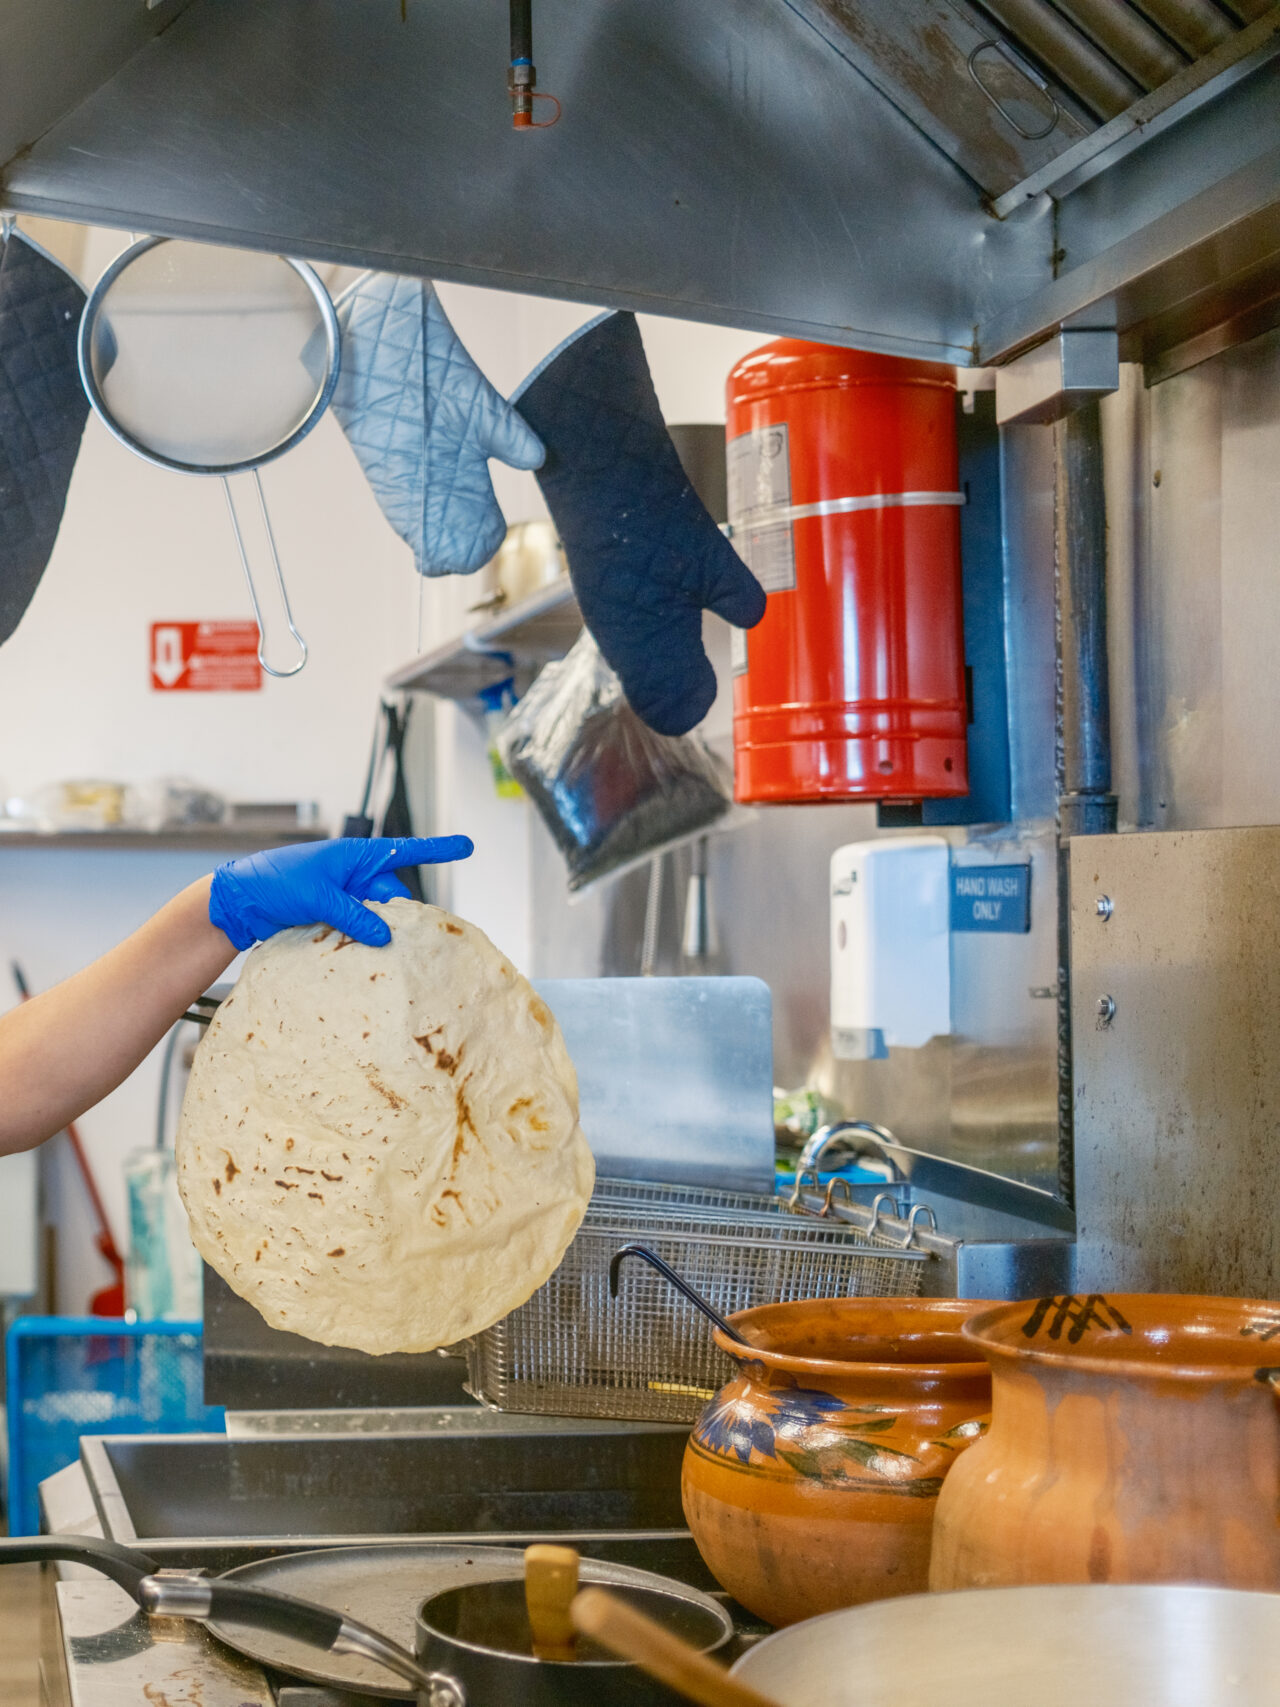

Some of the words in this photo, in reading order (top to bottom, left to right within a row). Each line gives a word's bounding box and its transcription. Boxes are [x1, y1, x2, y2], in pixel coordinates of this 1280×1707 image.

[956, 877, 985, 896] HAND
[987, 877, 1018, 897] WASH
[973, 901, 1001, 920] ONLY
